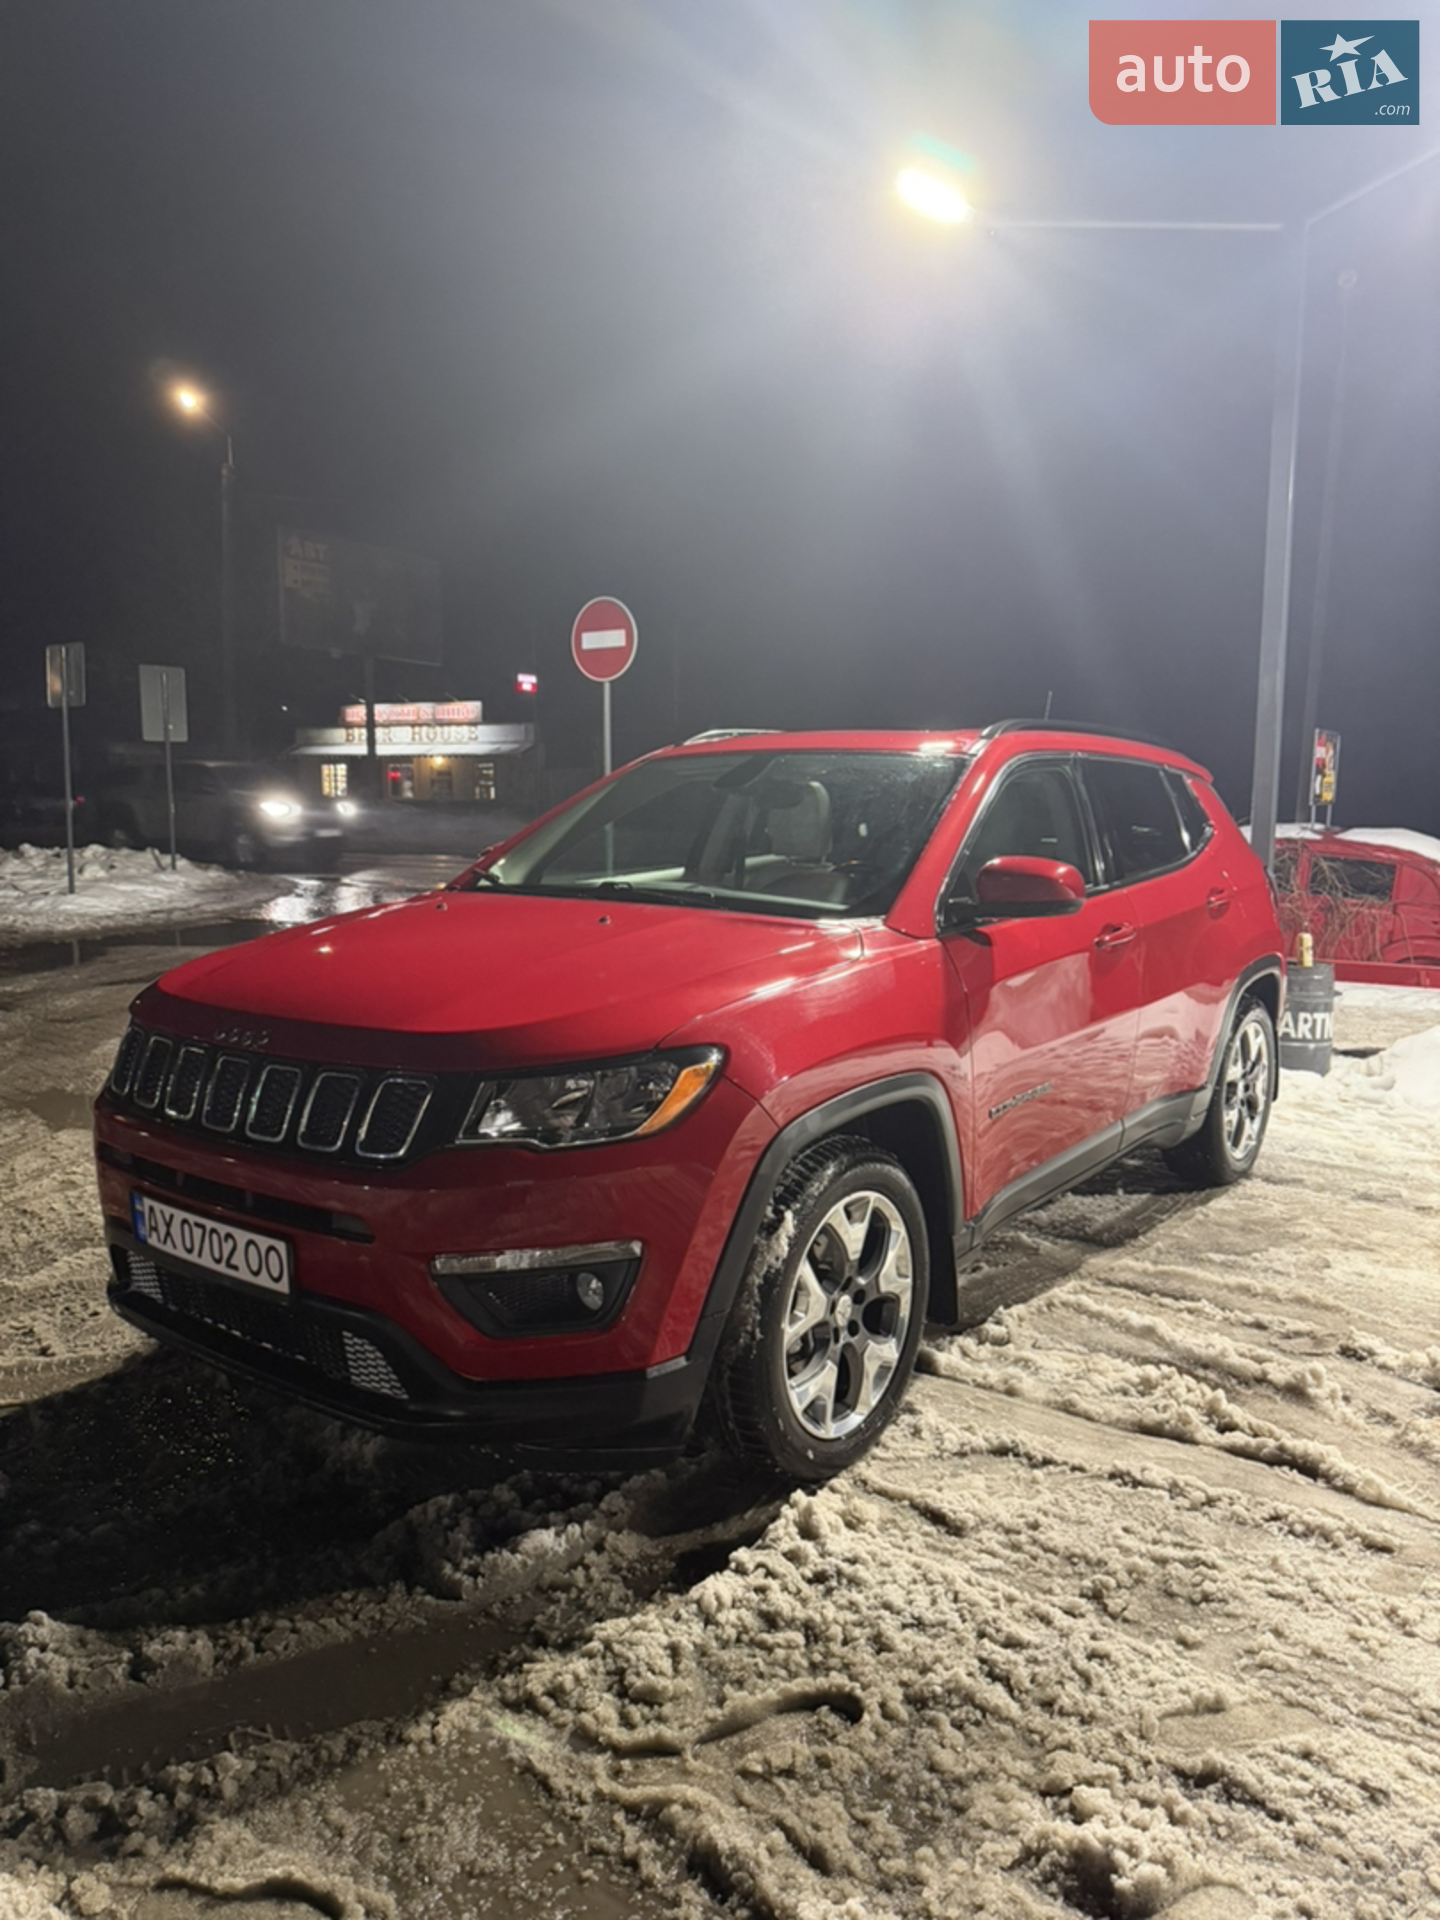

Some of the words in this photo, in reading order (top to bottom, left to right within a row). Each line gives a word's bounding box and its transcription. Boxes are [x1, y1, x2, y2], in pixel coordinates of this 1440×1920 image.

[345, 727, 392, 743] BER
[411, 724, 479, 743] HOUSE
[148, 1204, 177, 1250] AX
[180, 1218, 240, 1273] 0702
